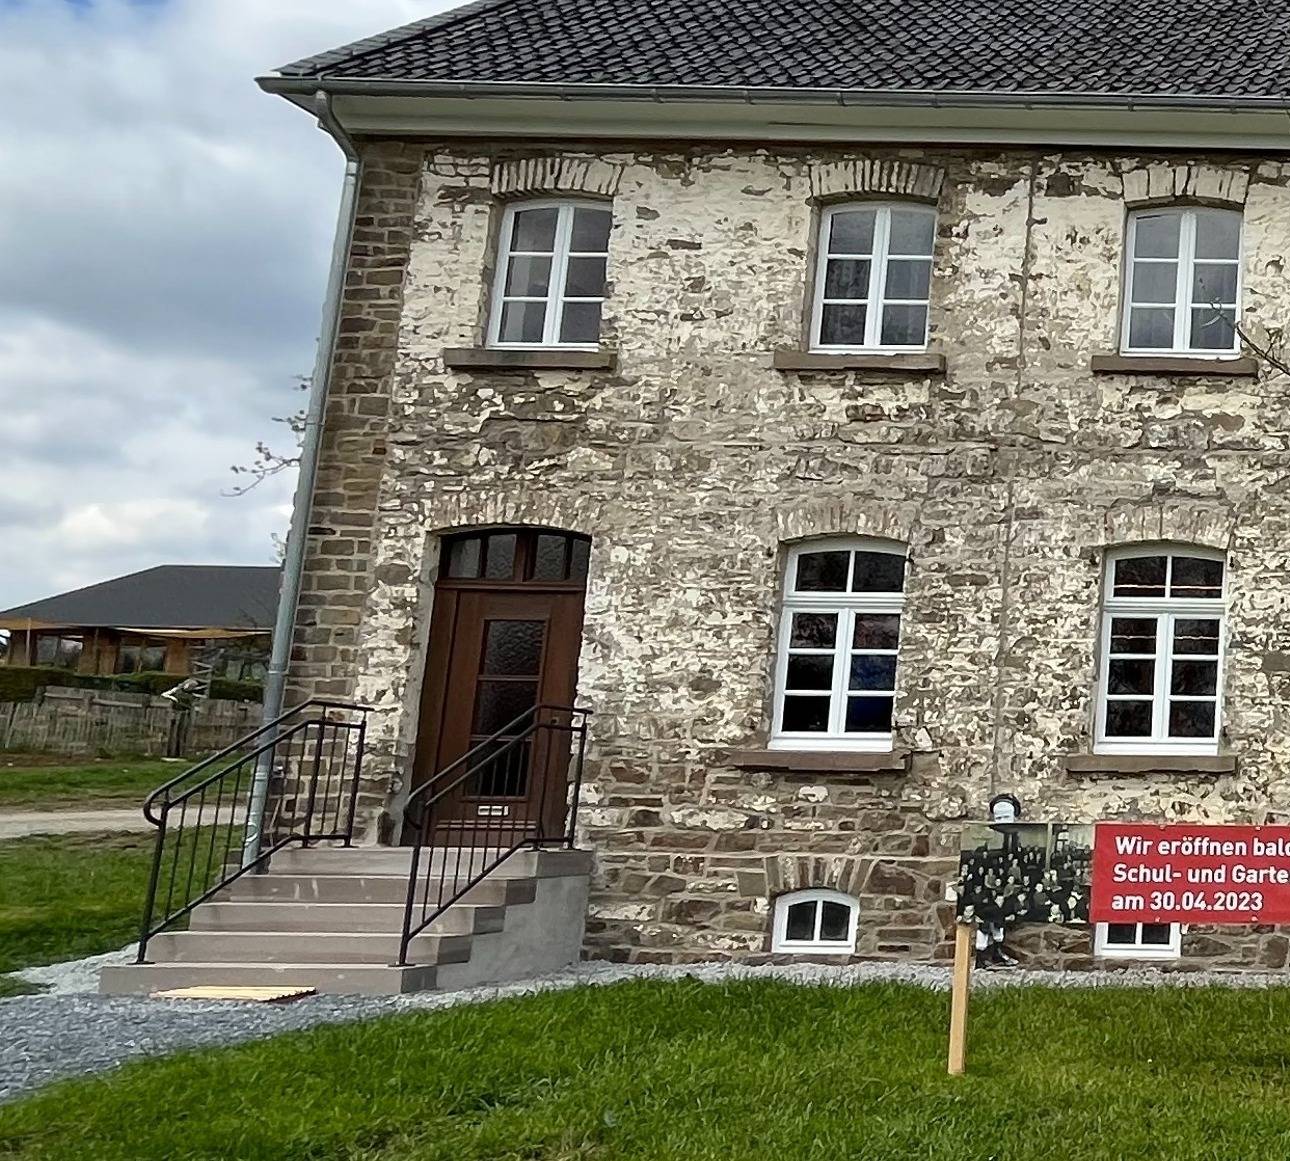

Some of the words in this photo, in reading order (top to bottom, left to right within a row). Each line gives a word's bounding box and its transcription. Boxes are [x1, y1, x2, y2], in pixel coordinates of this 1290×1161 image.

[1115, 836, 1153, 855] Wir
[1157, 837, 1247, 856] eröffnen
[1113, 864, 1182, 883] Schul-
[1187, 865, 1226, 884] und
[1111, 895, 1144, 911] am
[1149, 891, 1264, 911] 30.04.2023
